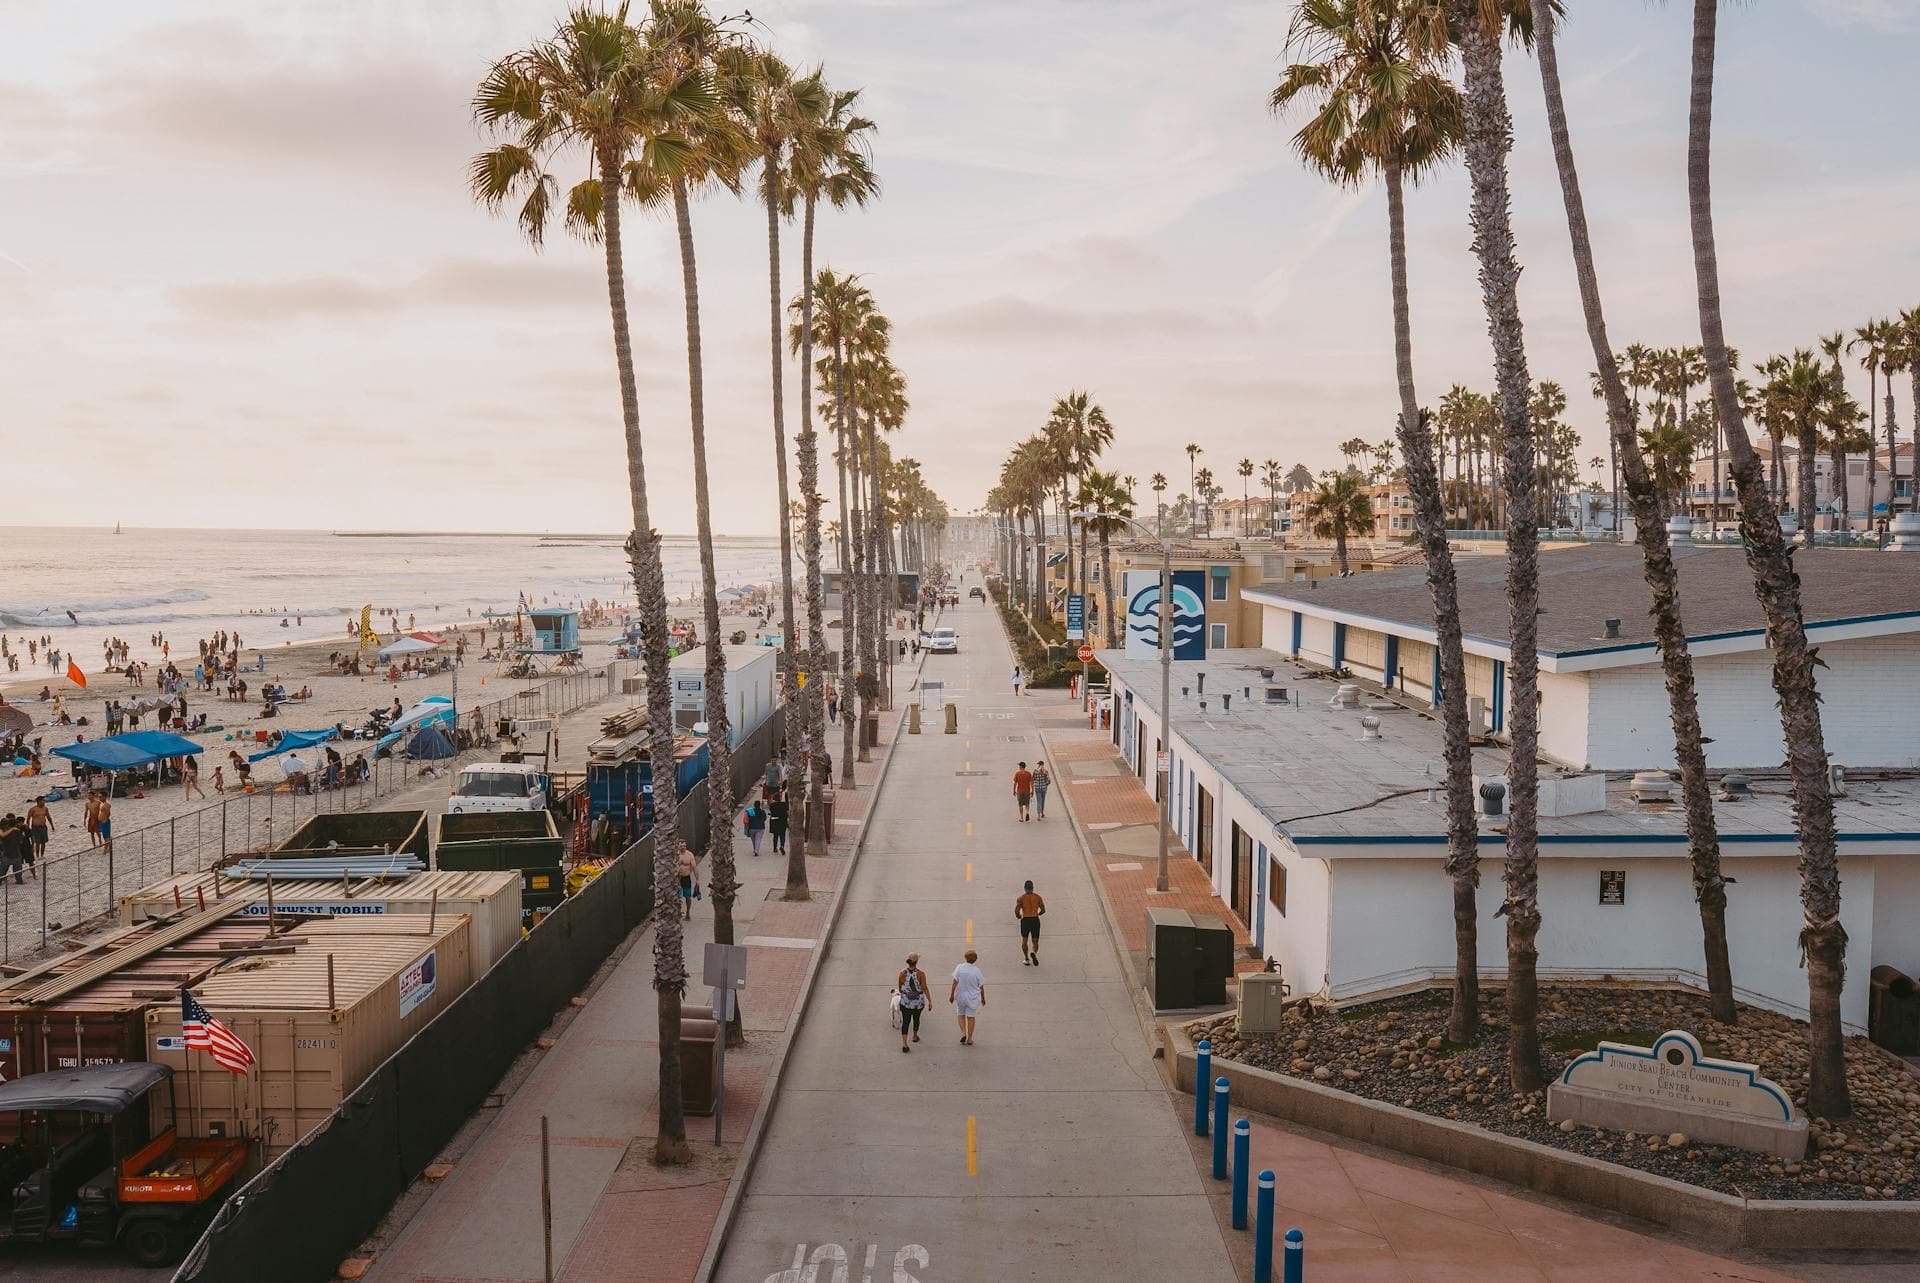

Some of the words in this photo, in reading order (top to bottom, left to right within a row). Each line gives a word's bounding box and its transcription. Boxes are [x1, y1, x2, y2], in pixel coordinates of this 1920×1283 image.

[544, 634, 549, 642] 2
[243, 905, 323, 915] SOUHWEST
[329, 905, 383, 915] MOBILE
[400, 965, 421, 991] AZTEC
[297, 1039, 326, 1049] 282411
[58, 1057, 78, 1067] TGHU
[1610, 1055, 1636, 1070] JUNIOR
[1638, 1060, 1658, 1073] SEAU
[1660, 1063, 1687, 1079] BEACH
[1689, 1068, 1741, 1088] COMMUNITY
[1657, 1077, 1690, 1093] CENTER
[1618, 1083, 1642, 1093] CITY
[1649, 1088, 1661, 1096] OF
[1668, 1091, 1733, 1107] OCEANSIDE
[124, 1185, 153, 1193] KUBOTA
